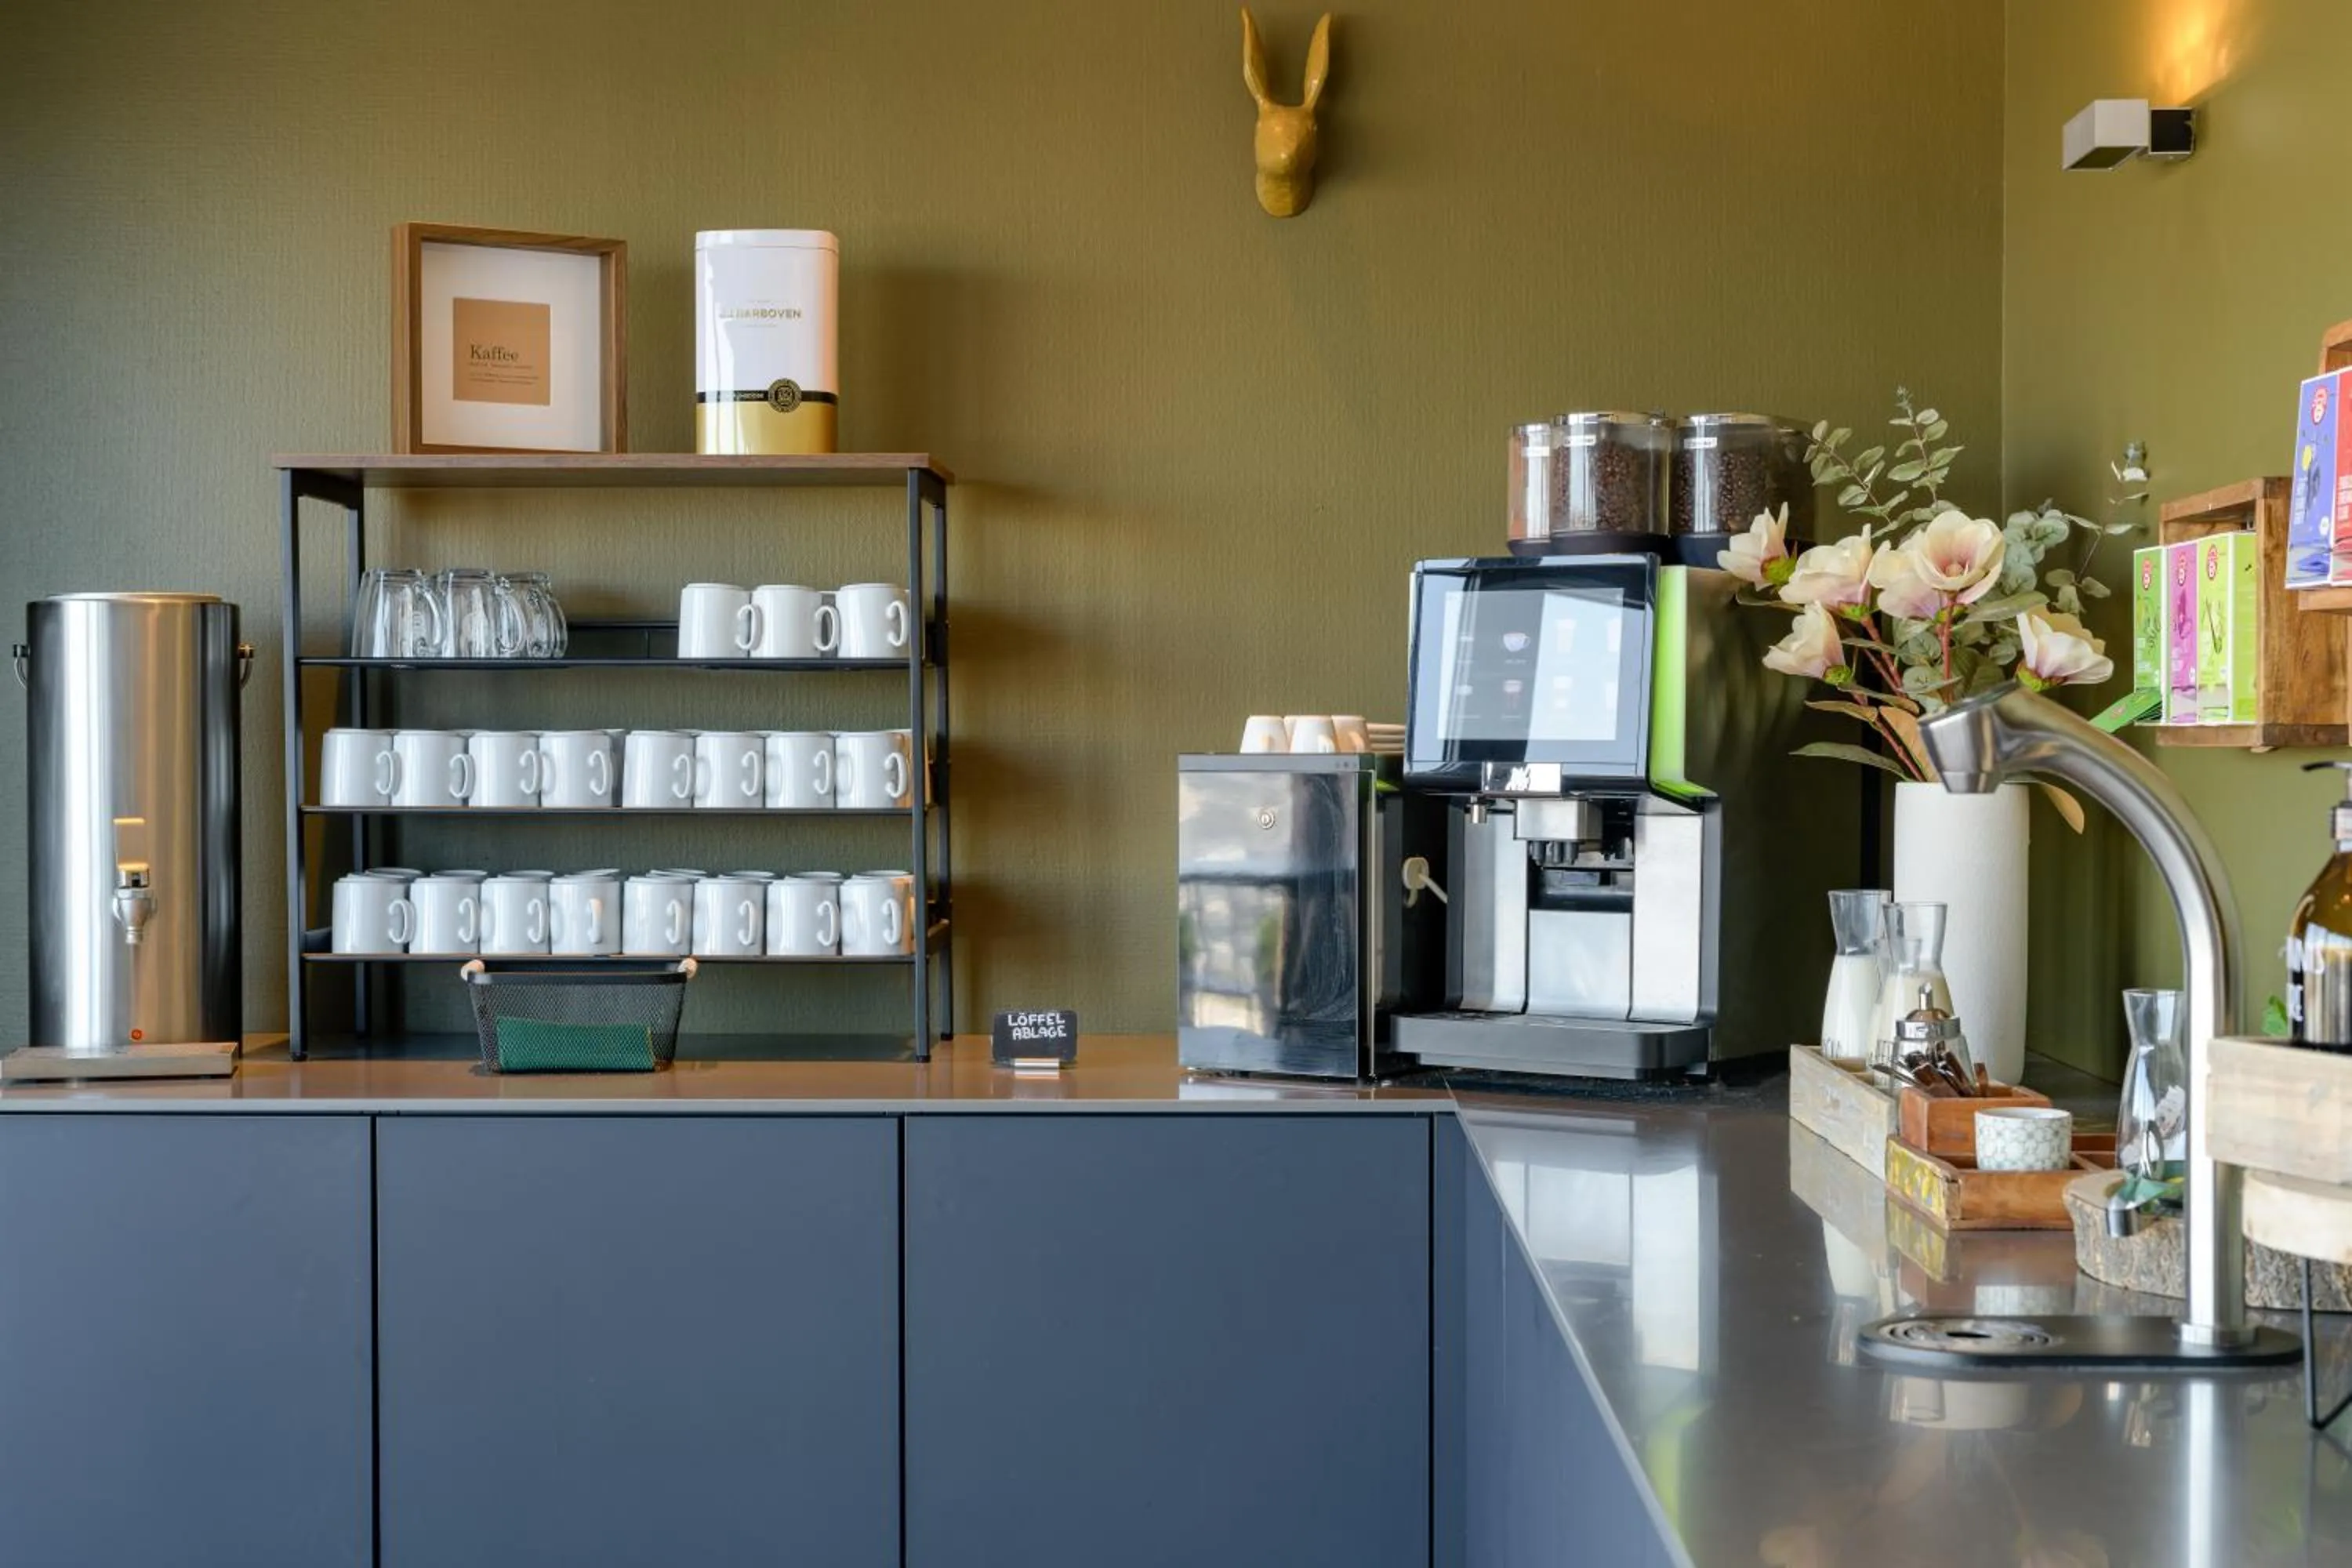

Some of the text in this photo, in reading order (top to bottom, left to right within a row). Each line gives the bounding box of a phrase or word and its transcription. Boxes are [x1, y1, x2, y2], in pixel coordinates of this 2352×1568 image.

[470, 345, 519, 362] Kaffee
[1007, 1012, 1065, 1026] LÖFFEL
[1012, 1025, 1067, 1040] ABLAGE
